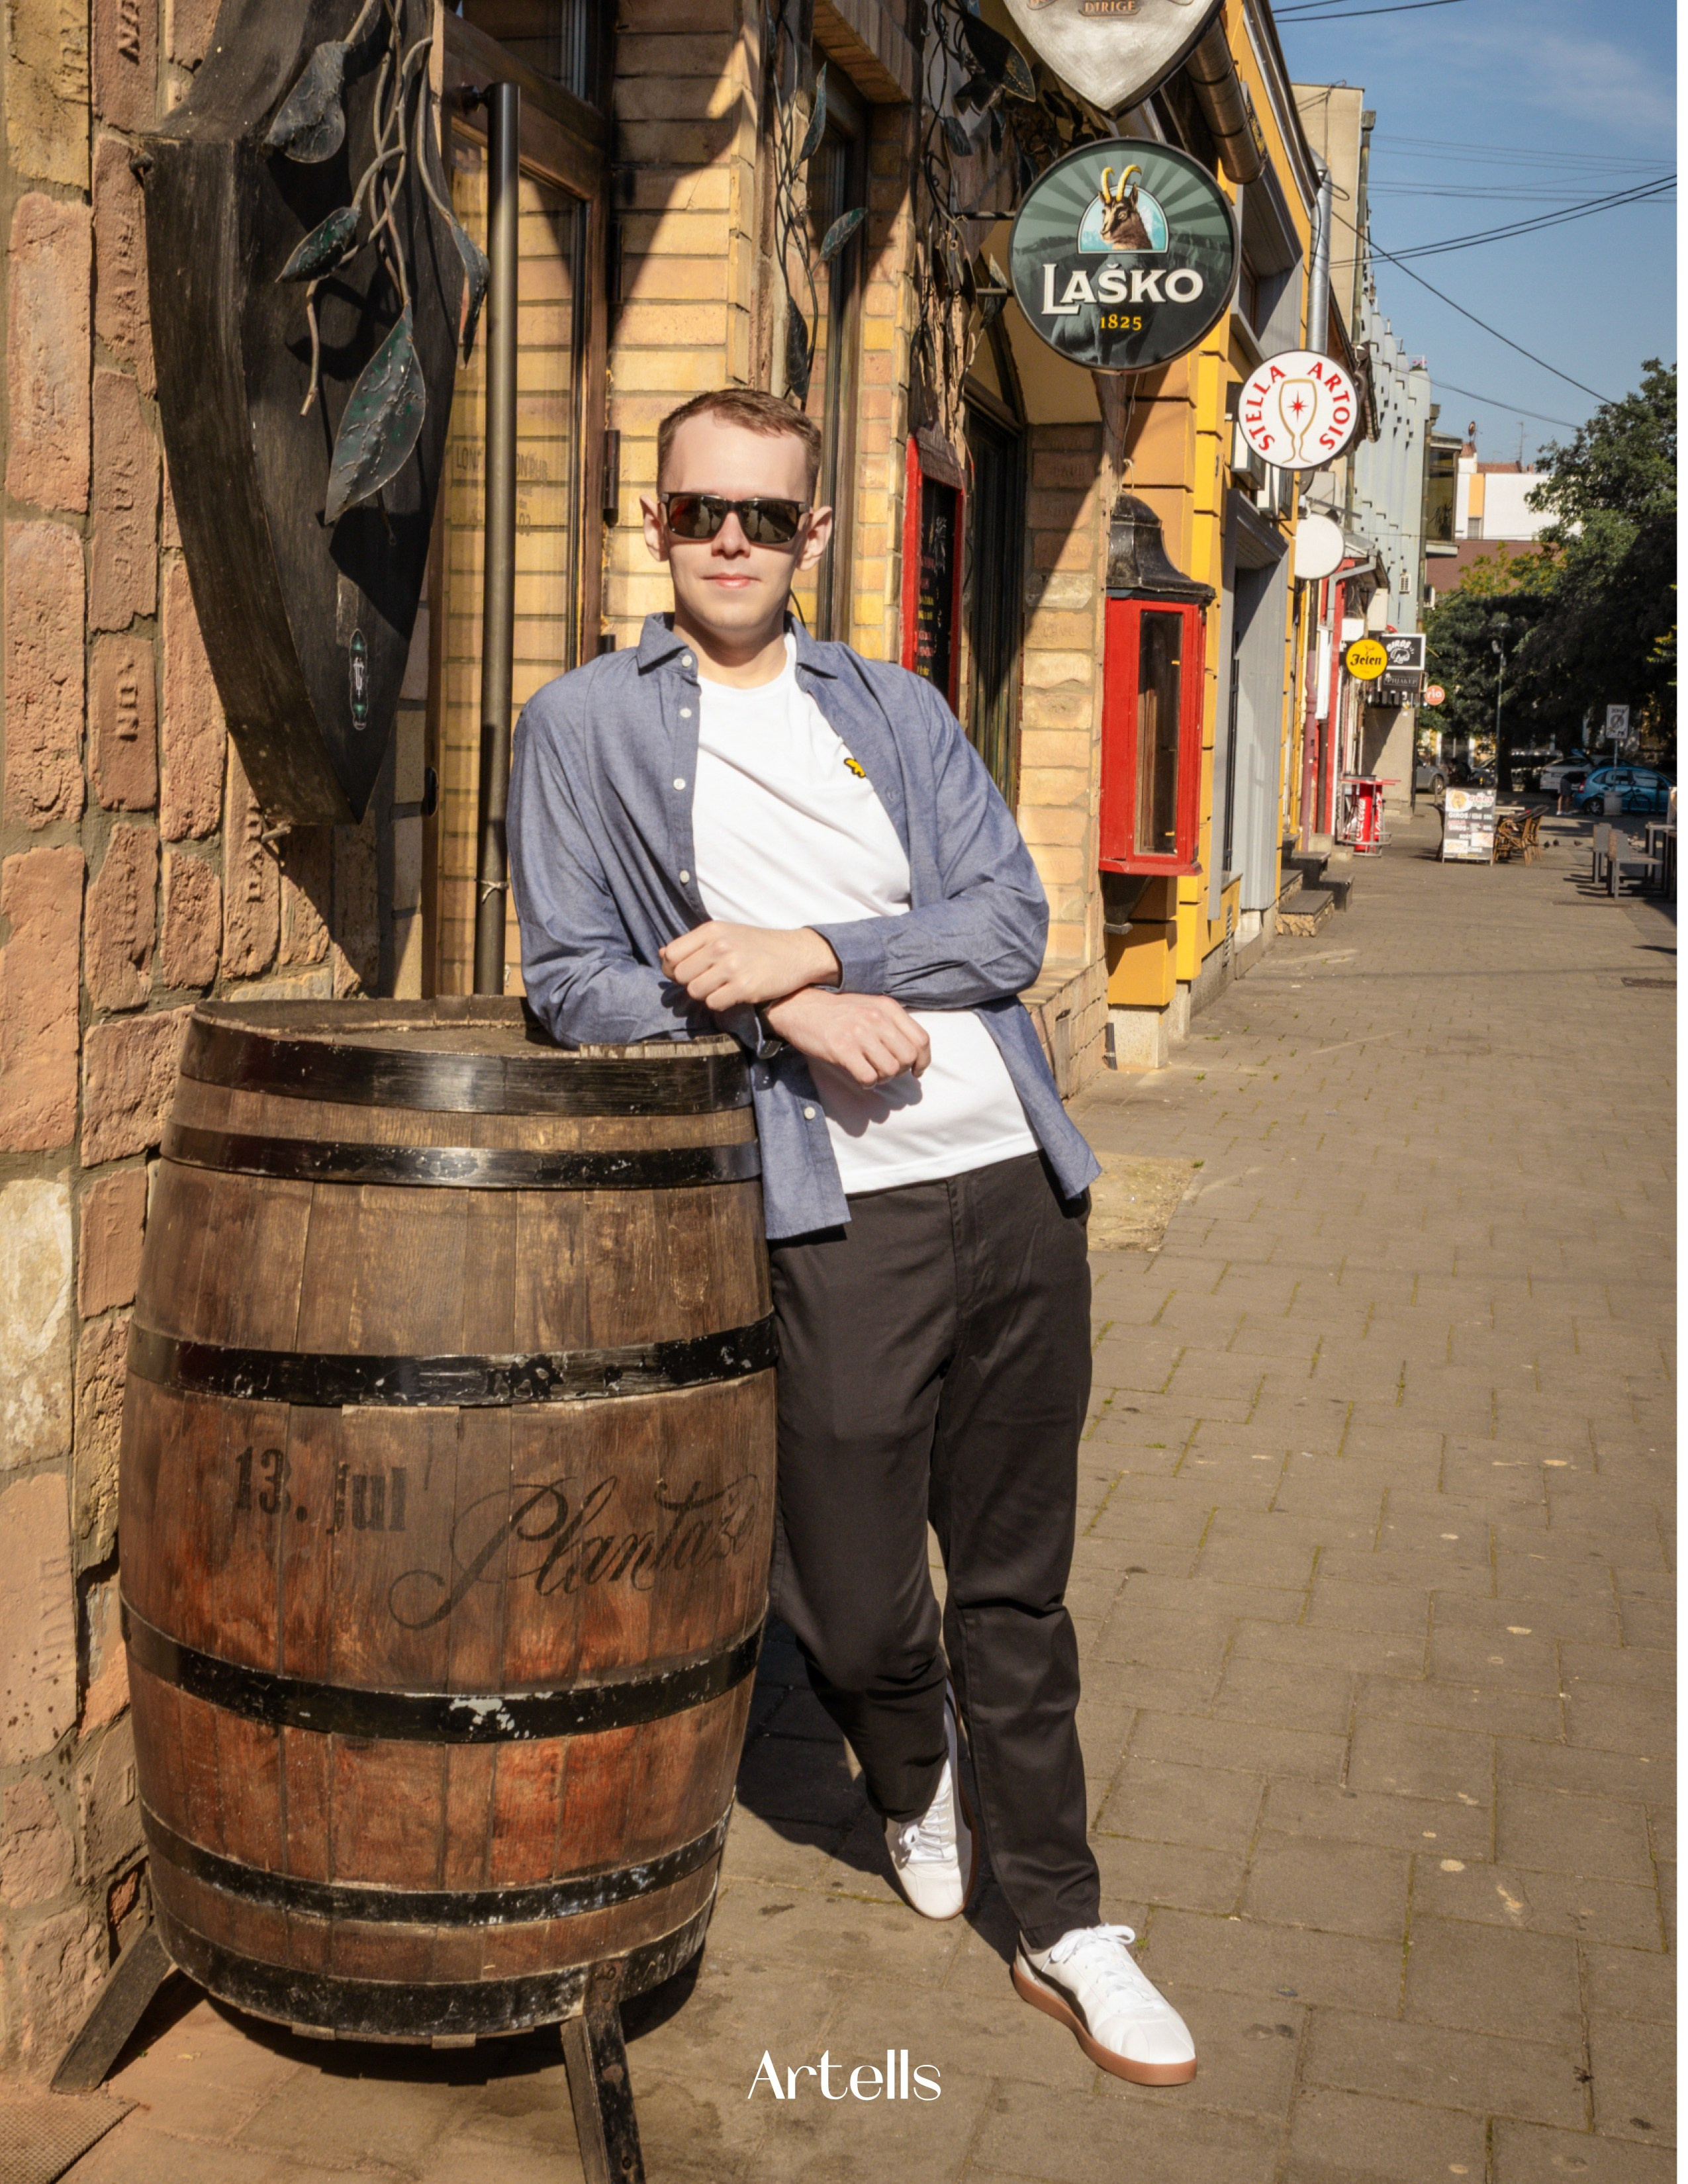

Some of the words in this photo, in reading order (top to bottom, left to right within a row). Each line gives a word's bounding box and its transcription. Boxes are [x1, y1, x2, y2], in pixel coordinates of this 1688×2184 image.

[1084, 1, 1137, 13] DIRIGE
[1041, 263, 1204, 315] LAŠKO
[1100, 314, 1143, 331] 1825
[1245, 365, 1286, 451] STELLA
[1307, 361, 1350, 450] ARTOIS
[1350, 654, 1382, 666] Jelen
[236, 1445, 308, 1522] 13.
[326, 1460, 407, 1535] jul
